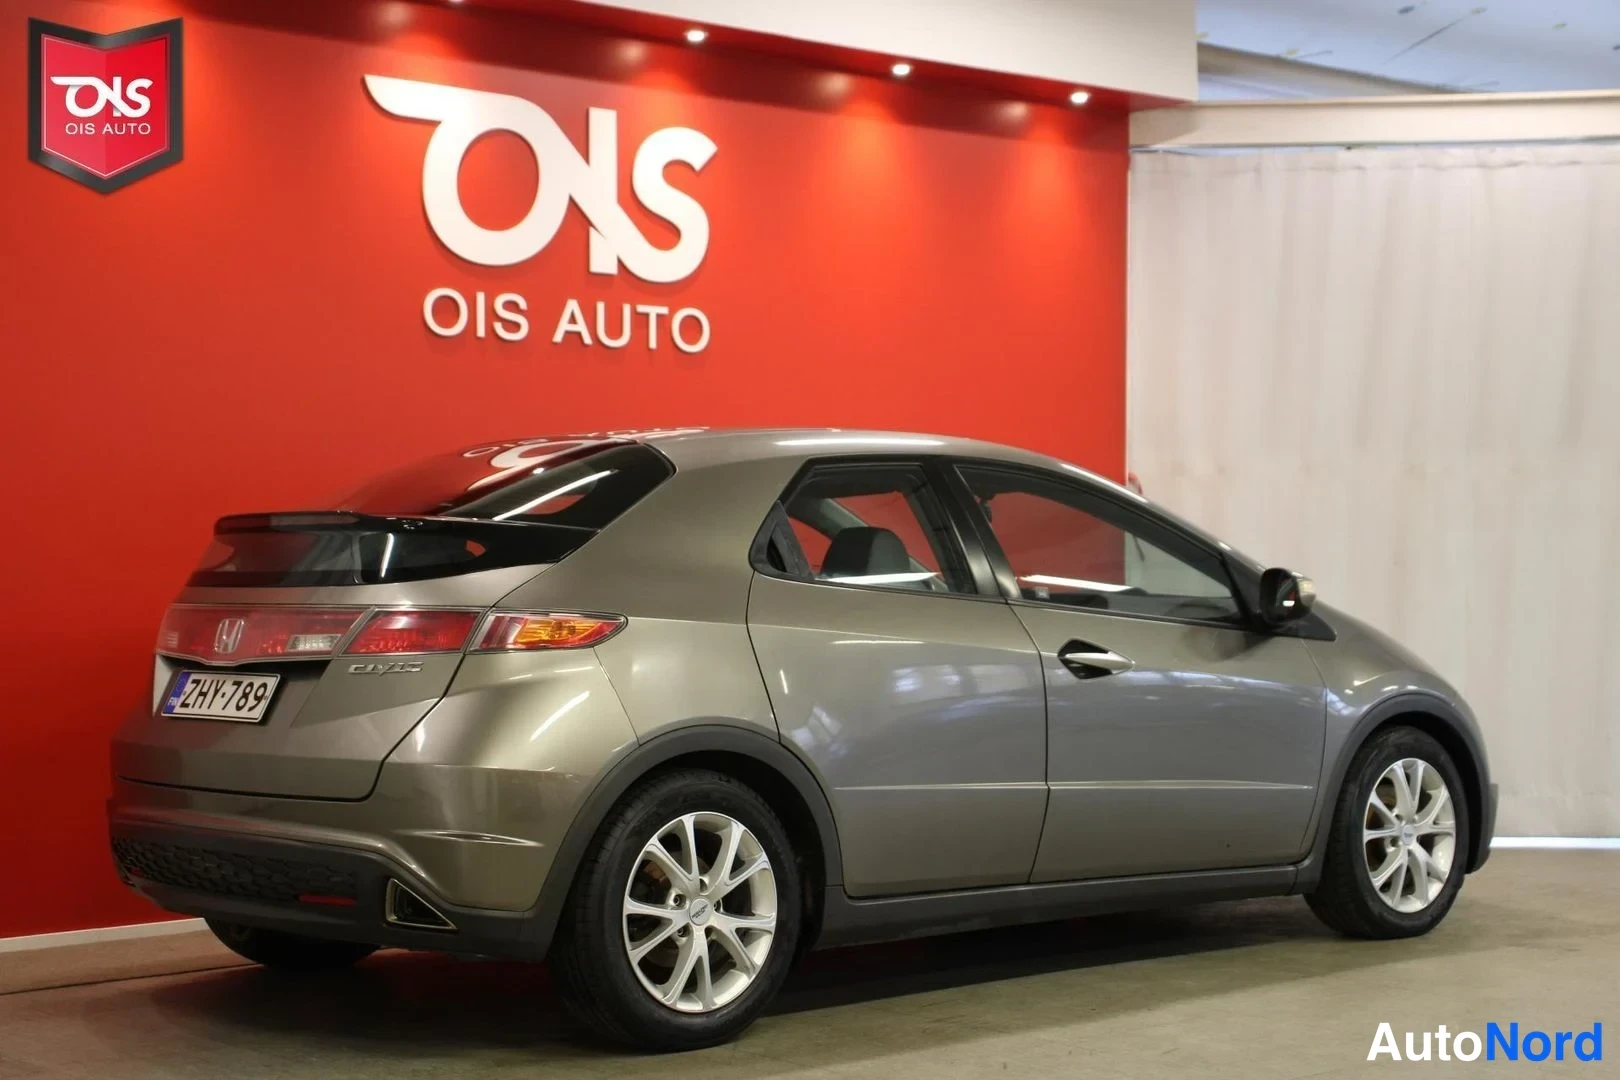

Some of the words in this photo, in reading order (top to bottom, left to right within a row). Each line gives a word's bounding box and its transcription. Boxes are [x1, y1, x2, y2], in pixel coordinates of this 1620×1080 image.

[364, 74, 718, 283] OIS
[422, 287, 530, 341] OIS
[552, 299, 711, 353] AUTO
[348, 661, 424, 676] CIVIC
[179, 679, 268, 712] ZHY-789
